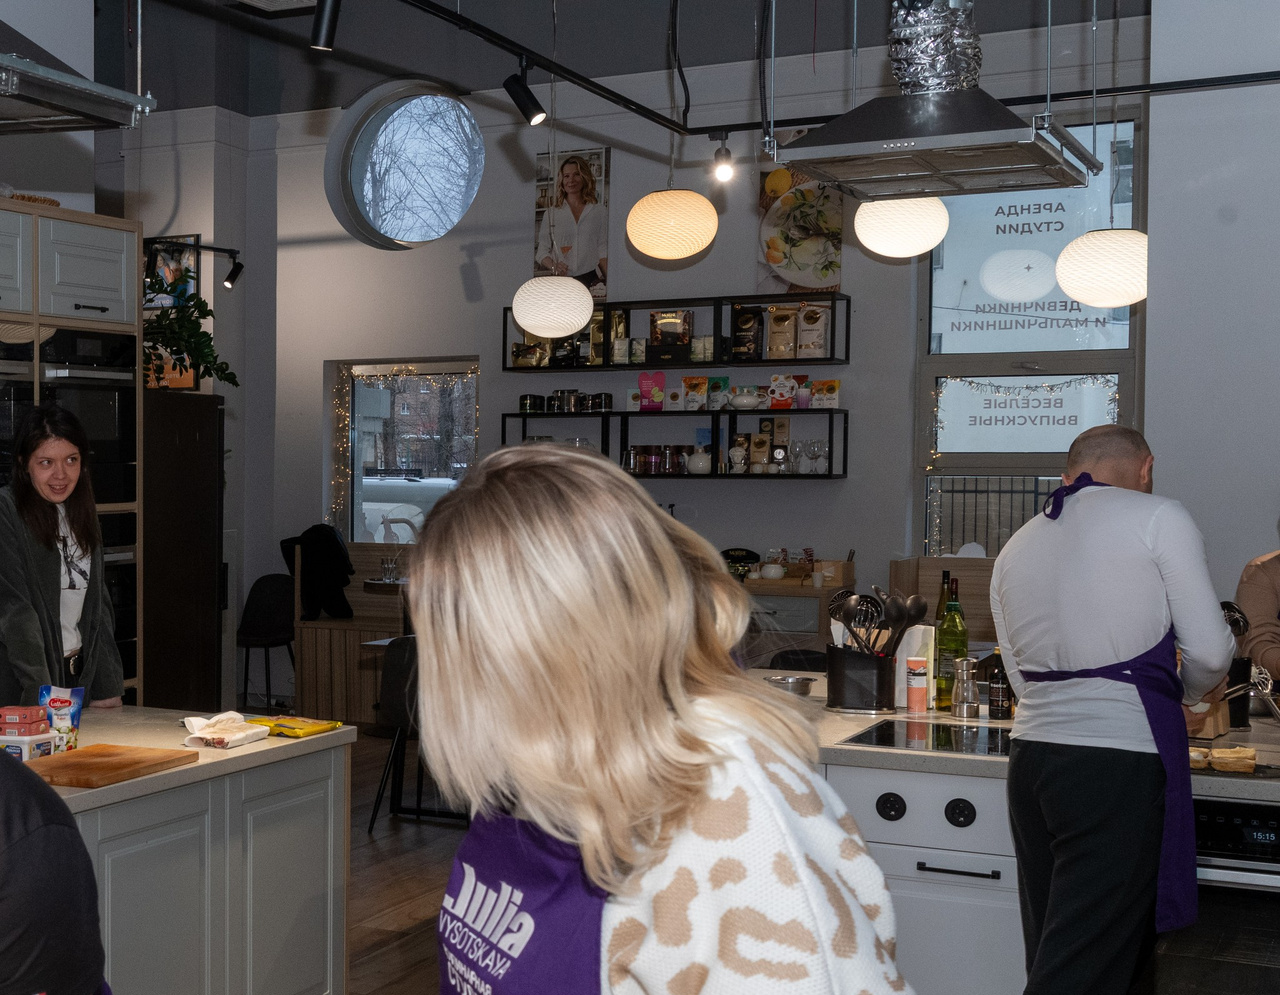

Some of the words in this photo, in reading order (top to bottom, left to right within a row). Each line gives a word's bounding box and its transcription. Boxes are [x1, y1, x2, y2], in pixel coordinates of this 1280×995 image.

[1252, 831, 1276, 841] 15:15
[439, 909, 512, 980] VYSOTSKAYA
[442, 861, 536, 959] Julia
